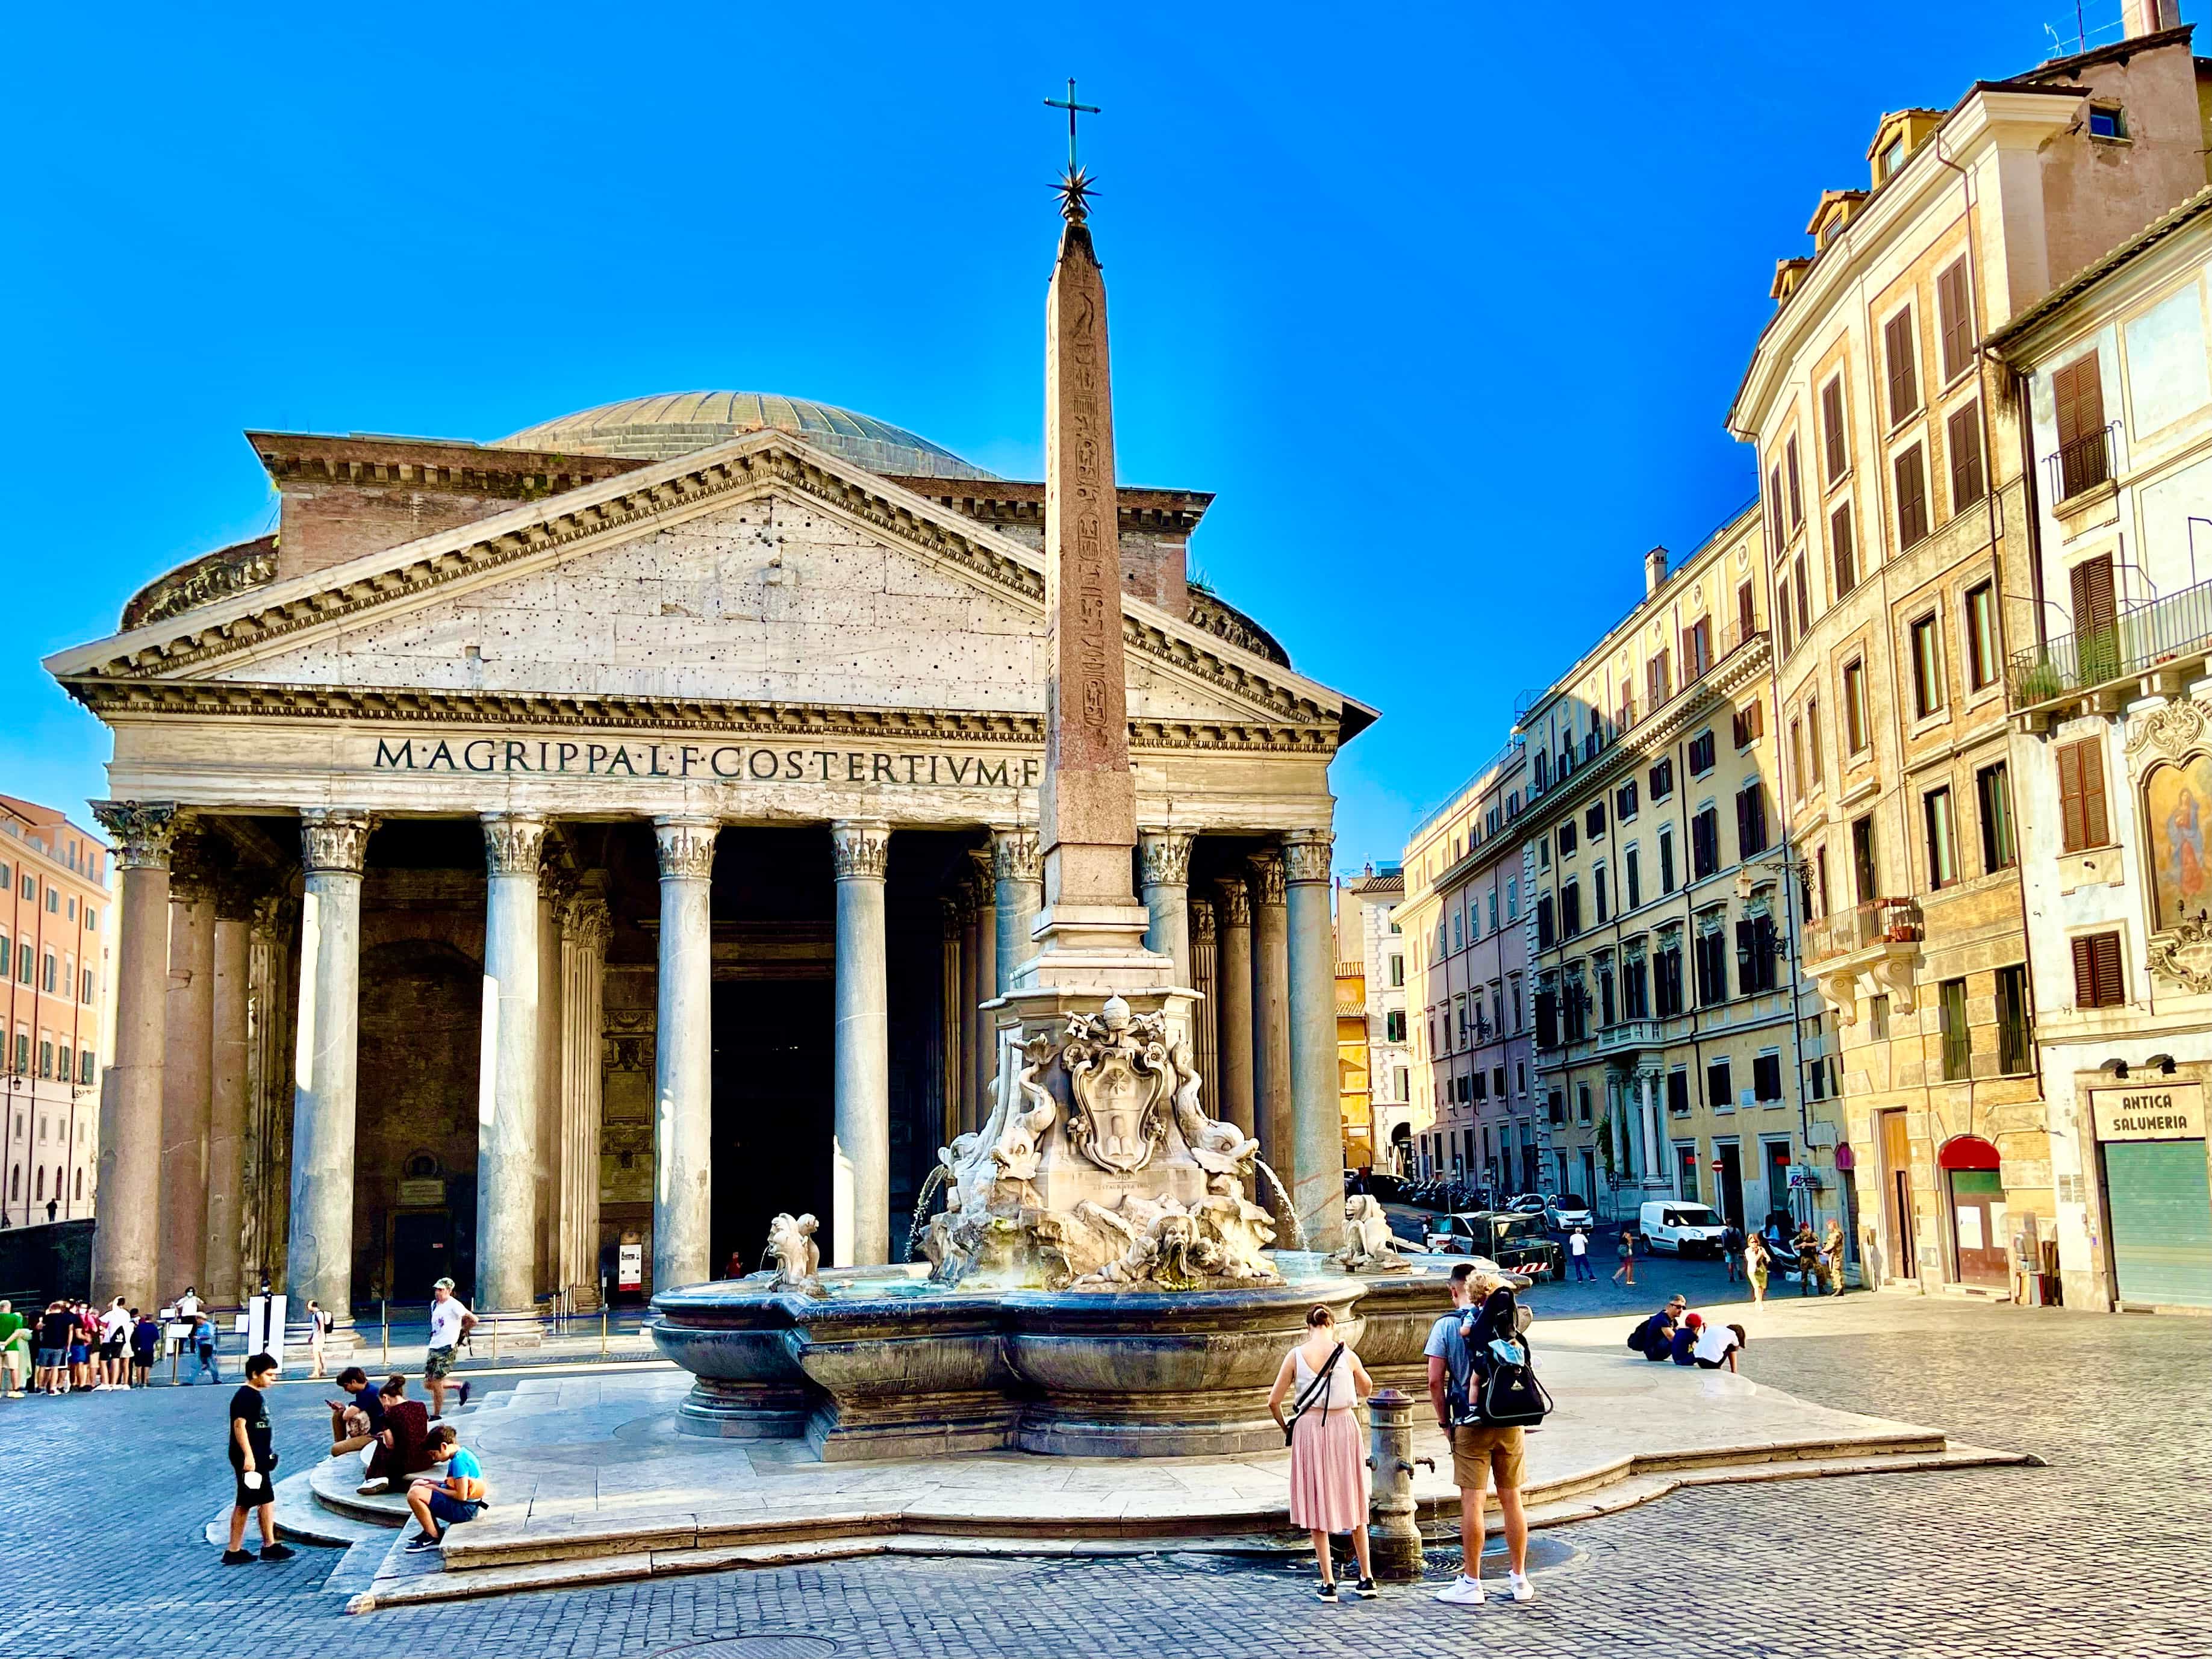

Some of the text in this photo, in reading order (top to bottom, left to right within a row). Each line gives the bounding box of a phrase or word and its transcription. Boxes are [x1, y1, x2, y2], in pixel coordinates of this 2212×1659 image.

[424, 739, 639, 775] AGRIPPA
[711, 747, 803, 779] COS
[813, 752, 1011, 786] TERTIVM
[2123, 1094, 2172, 1110] ANTICA
[2113, 1115, 2187, 1131] SALUMERIA
